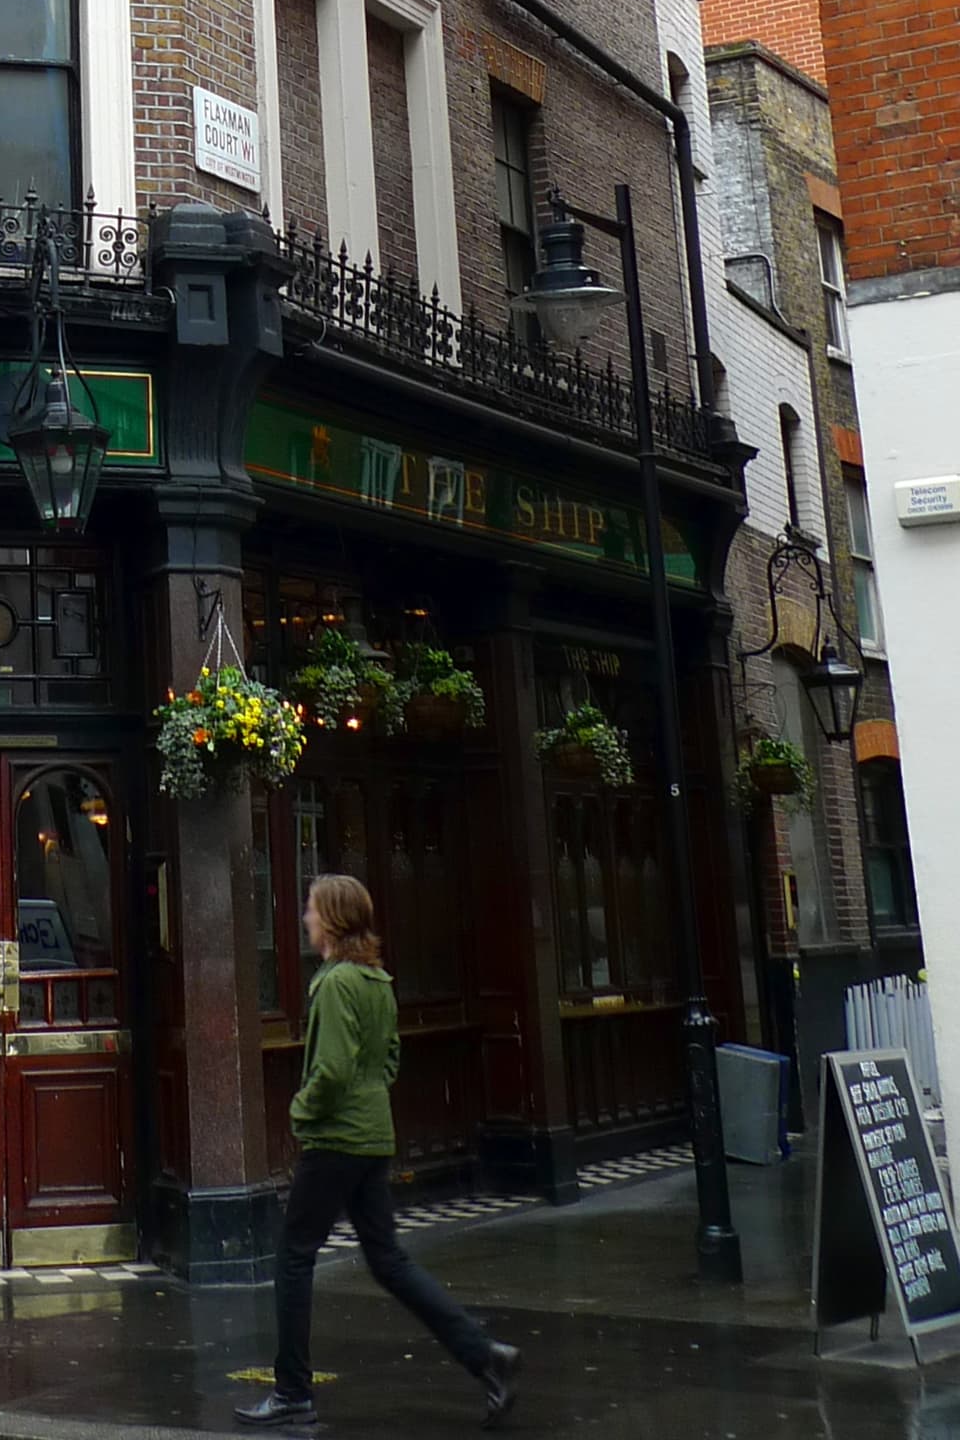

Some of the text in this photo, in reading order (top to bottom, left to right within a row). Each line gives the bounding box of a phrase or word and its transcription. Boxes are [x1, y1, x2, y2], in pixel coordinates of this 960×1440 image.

[204, 98, 251, 138] FLAXMAN
[205, 124, 255, 164] COURT W1
[397, 452, 607, 545] THE SHIP
[911, 486, 946, 496] Telecom
[911, 496, 947, 506] Security
[561, 644, 621, 678] THE SHIP
[670, 783, 680, 796] 5
